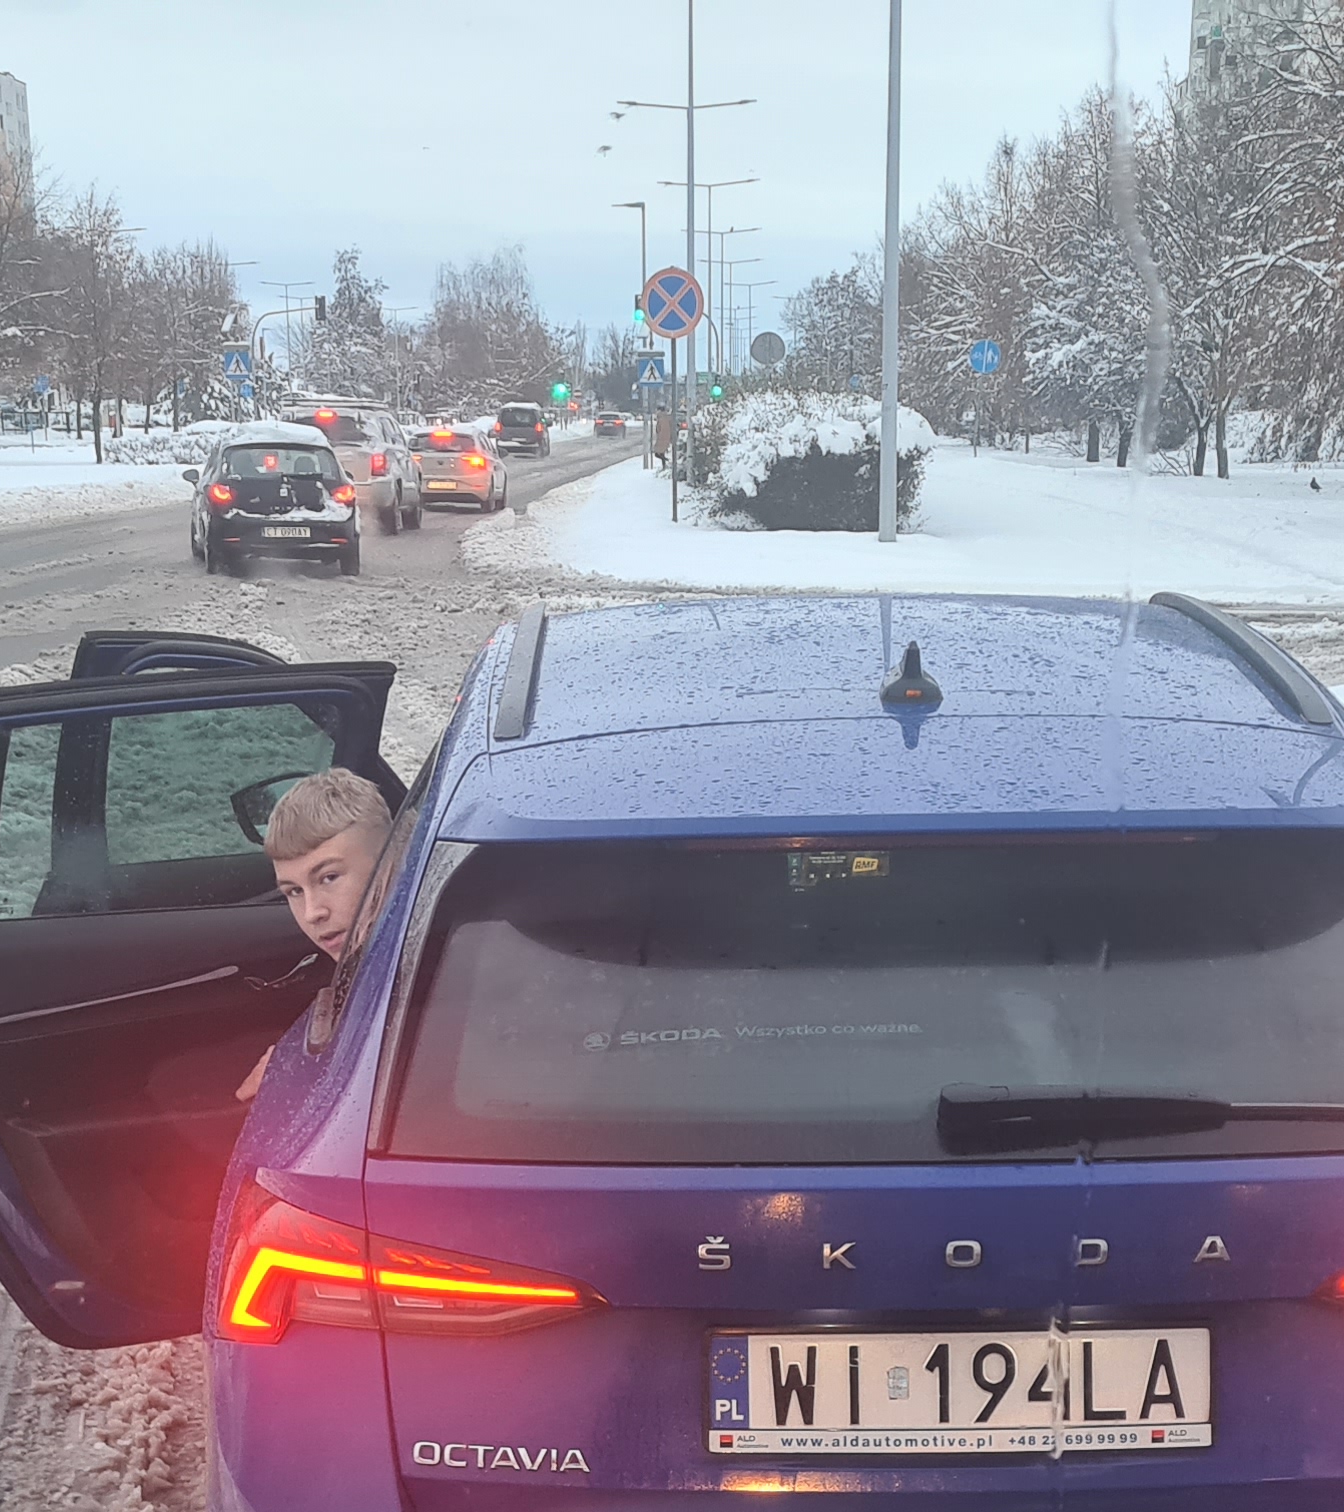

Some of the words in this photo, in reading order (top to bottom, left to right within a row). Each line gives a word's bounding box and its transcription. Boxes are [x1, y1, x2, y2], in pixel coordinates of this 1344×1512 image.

[854, 859, 877, 870] RMF
[620, 1026, 722, 1046] ŠKODA
[735, 1024, 827, 1038] Wszystko
[697, 1235, 1232, 1270] ŠKODA
[769, 1345, 860, 1427] WI
[715, 1399, 744, 1421] PL
[781, 1435, 992, 1447] www.aldautomotive.pl
[1008, 1435, 1036, 1446] +48
[1065, 1434, 1093, 1444] 699
[1097, 1434, 1115, 1444] 99
[1119, 1433, 1138, 1443] 99
[1168, 1429, 1187, 1437] ALD
[413, 1441, 591, 1473] OCTAVIA
